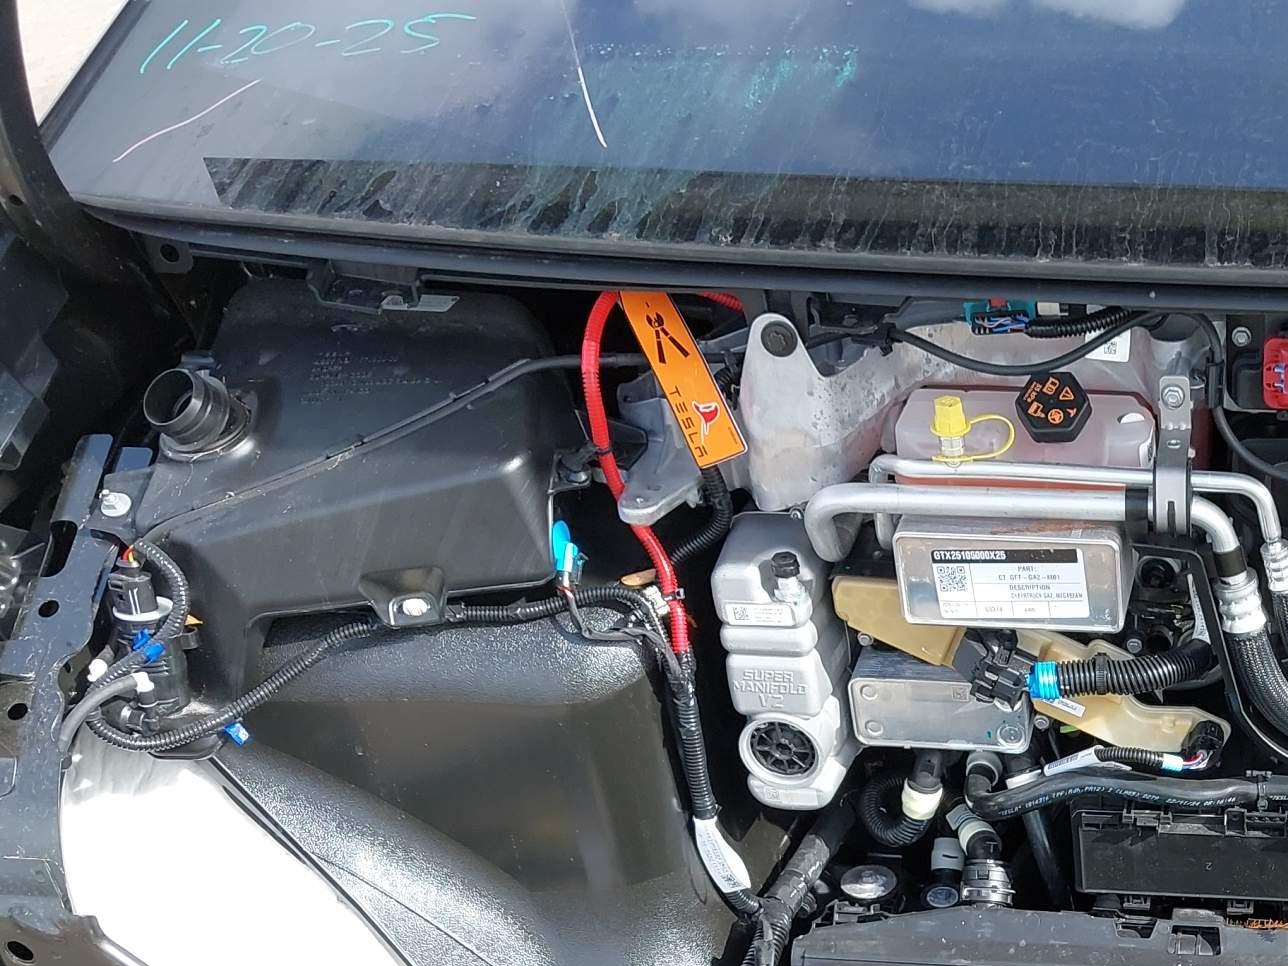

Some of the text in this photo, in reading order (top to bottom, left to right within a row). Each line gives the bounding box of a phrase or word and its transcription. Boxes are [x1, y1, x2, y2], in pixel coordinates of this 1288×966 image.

[139, 13, 477, 74] 11-20-25
[669, 385, 709, 458] TESLA
[743, 669, 794, 682] SUPER
[733, 680, 808, 695] MANIFOLD
[759, 693, 784, 709] V2
